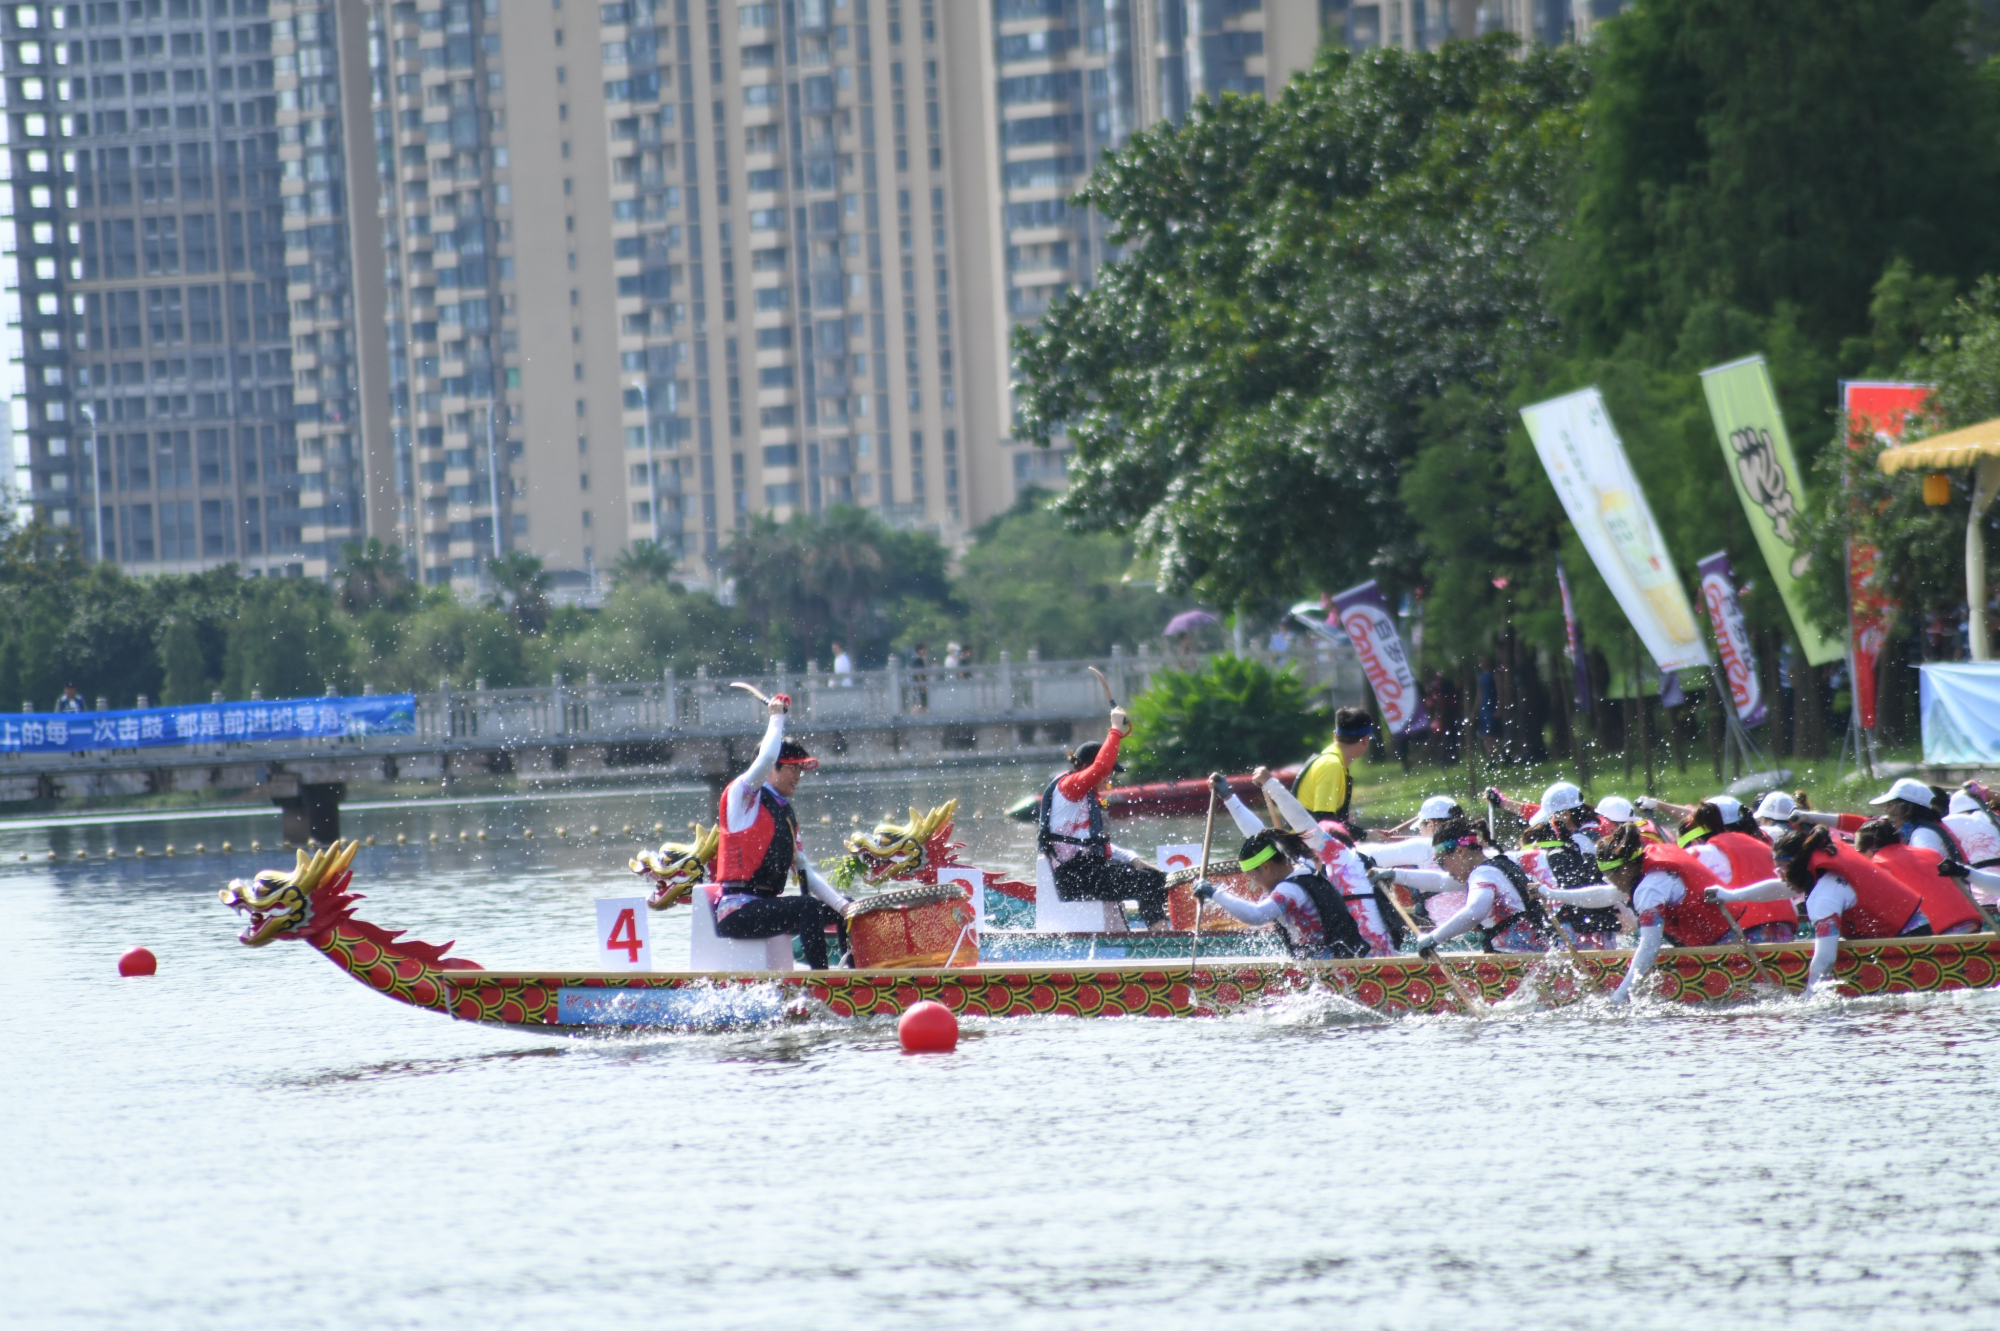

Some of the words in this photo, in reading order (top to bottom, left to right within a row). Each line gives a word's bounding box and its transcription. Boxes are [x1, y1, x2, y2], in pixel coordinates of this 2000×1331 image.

[0, 716, 163, 746] 上的每一次击鼓
[175, 705, 339, 738] 都是前进的号角
[607, 908, 643, 963] 4
